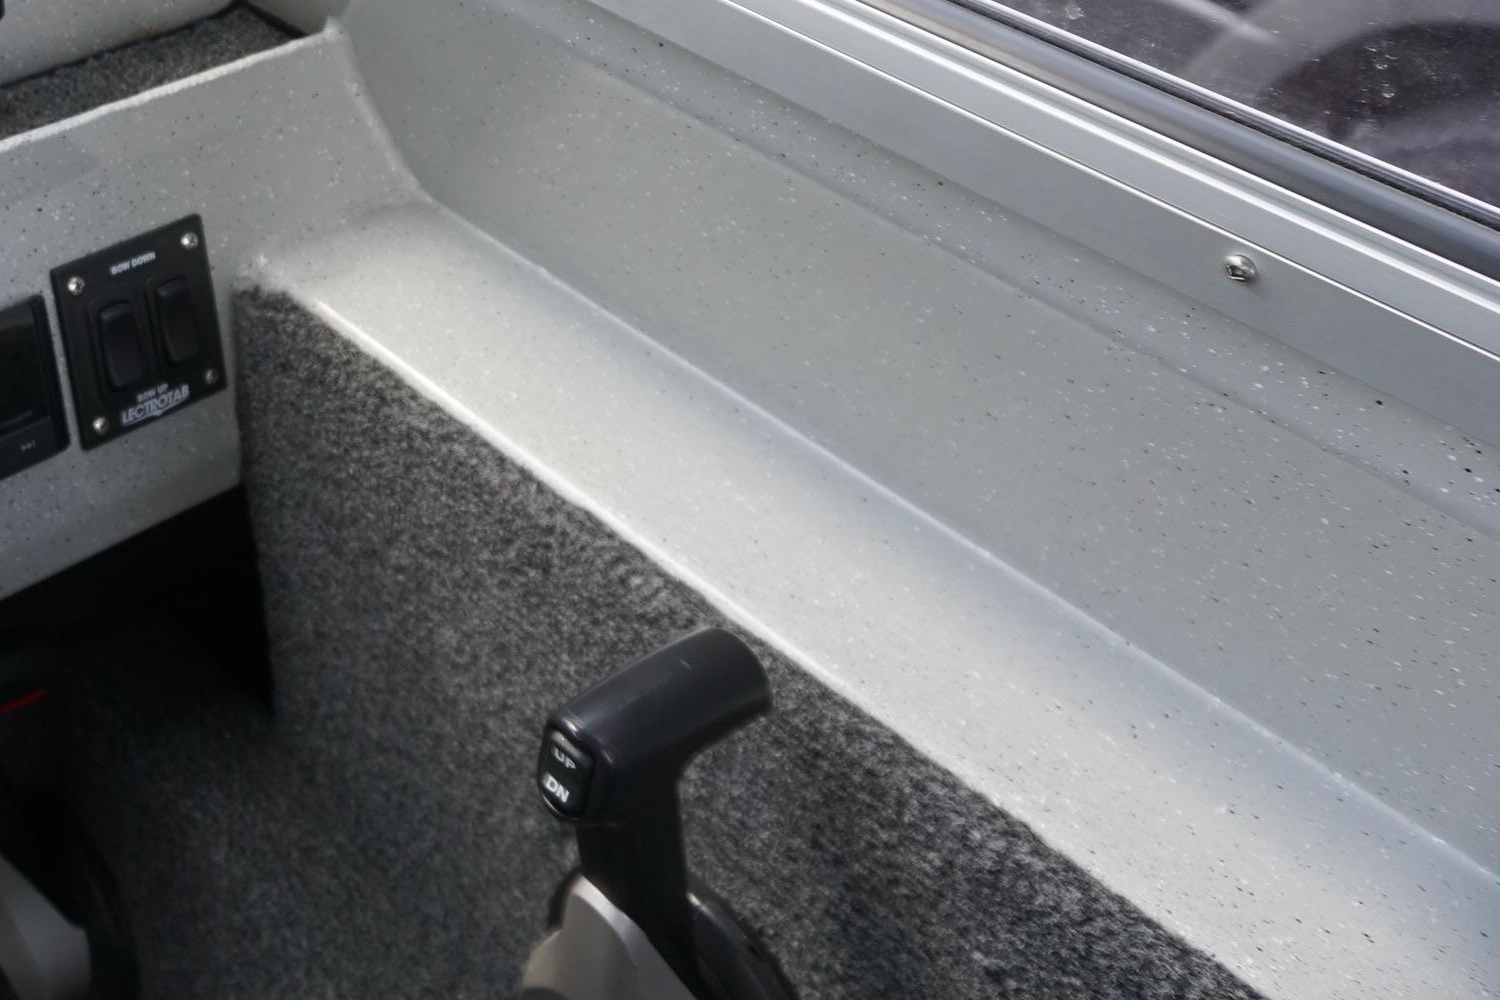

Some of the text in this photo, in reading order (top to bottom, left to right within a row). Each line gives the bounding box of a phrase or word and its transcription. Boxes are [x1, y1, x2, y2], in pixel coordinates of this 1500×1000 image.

[110, 251, 156, 276] BOW DOWN
[553, 746, 577, 770] UP
[543, 772, 571, 804] DN
